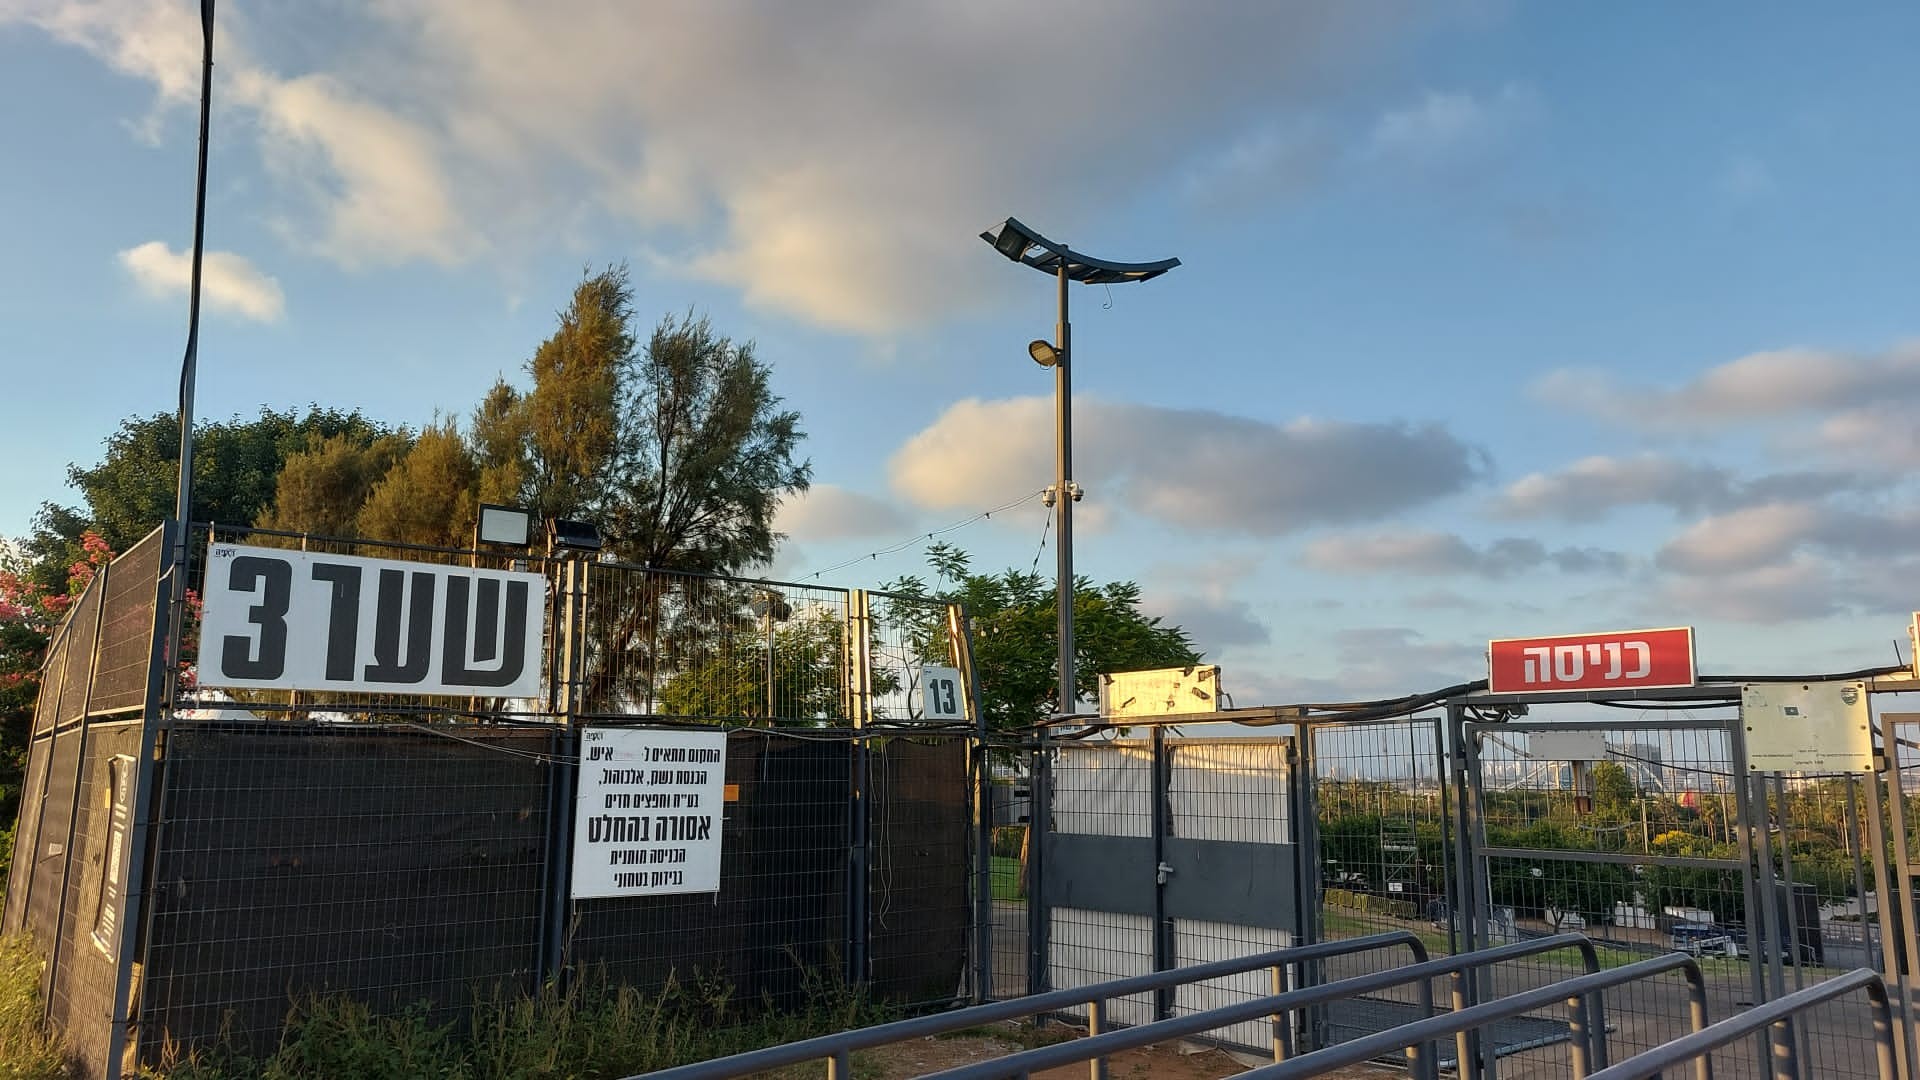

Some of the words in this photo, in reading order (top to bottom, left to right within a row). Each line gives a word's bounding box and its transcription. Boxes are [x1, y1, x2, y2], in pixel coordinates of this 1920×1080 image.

[221, 555, 293, 680] 3
[311, 562, 529, 687] שער
[1523, 640, 1651, 684] כניסה
[929, 678, 956, 715] 13
[585, 746, 614, 762] איש.
[652, 747, 687, 763] מתאים
[687, 748, 721, 765] המקום
[598, 767, 645, 786] אלכוהול,
[646, 769, 674, 787] נשק,
[675, 770, 708, 785] הכנסת
[604, 793, 631, 809] חדים
[633, 793, 670, 809] וחפצים
[588, 813, 650, 843] בהחלט
[655, 815, 712, 842] אסורה
[609, 849, 647, 865] מותנית
[649, 848, 687, 864] הכניסה
[613, 871, 649, 889] בטחוני
[651, 870, 684, 889] בבידוק
